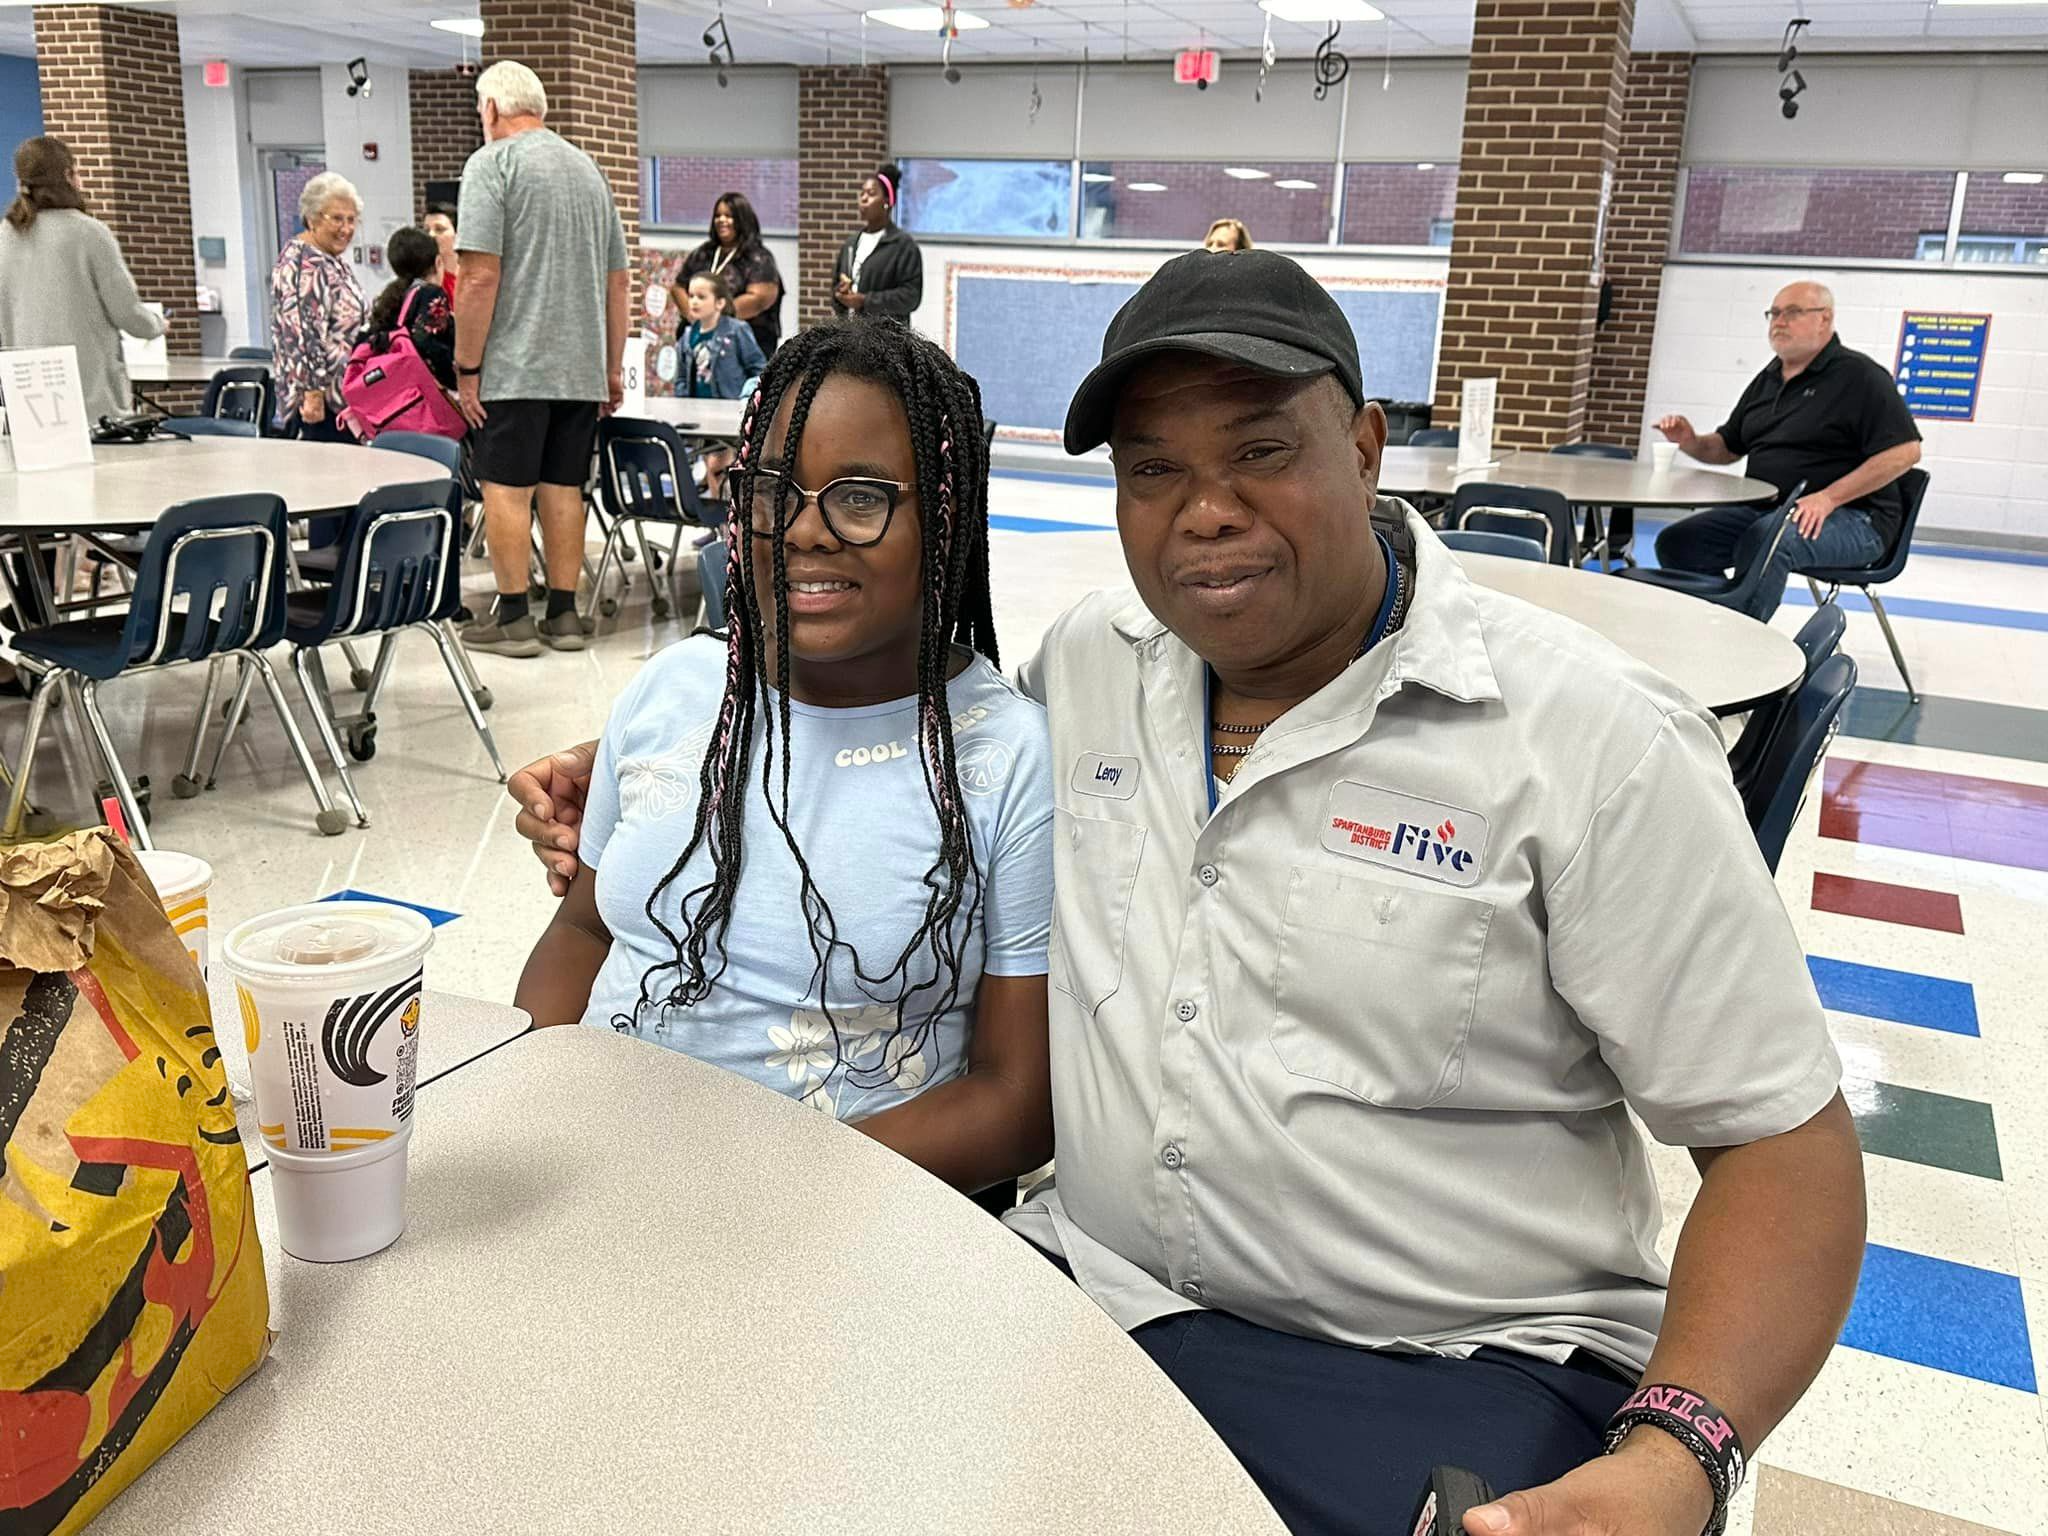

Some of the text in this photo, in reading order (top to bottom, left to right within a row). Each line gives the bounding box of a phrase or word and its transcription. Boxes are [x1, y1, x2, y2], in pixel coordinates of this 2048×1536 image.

[834, 740, 908, 768] COOL
[1095, 761, 1123, 786] Leroy
[1332, 817, 1474, 873] SPARTANBURG Five
[1350, 832, 1390, 851] DISTRICT
